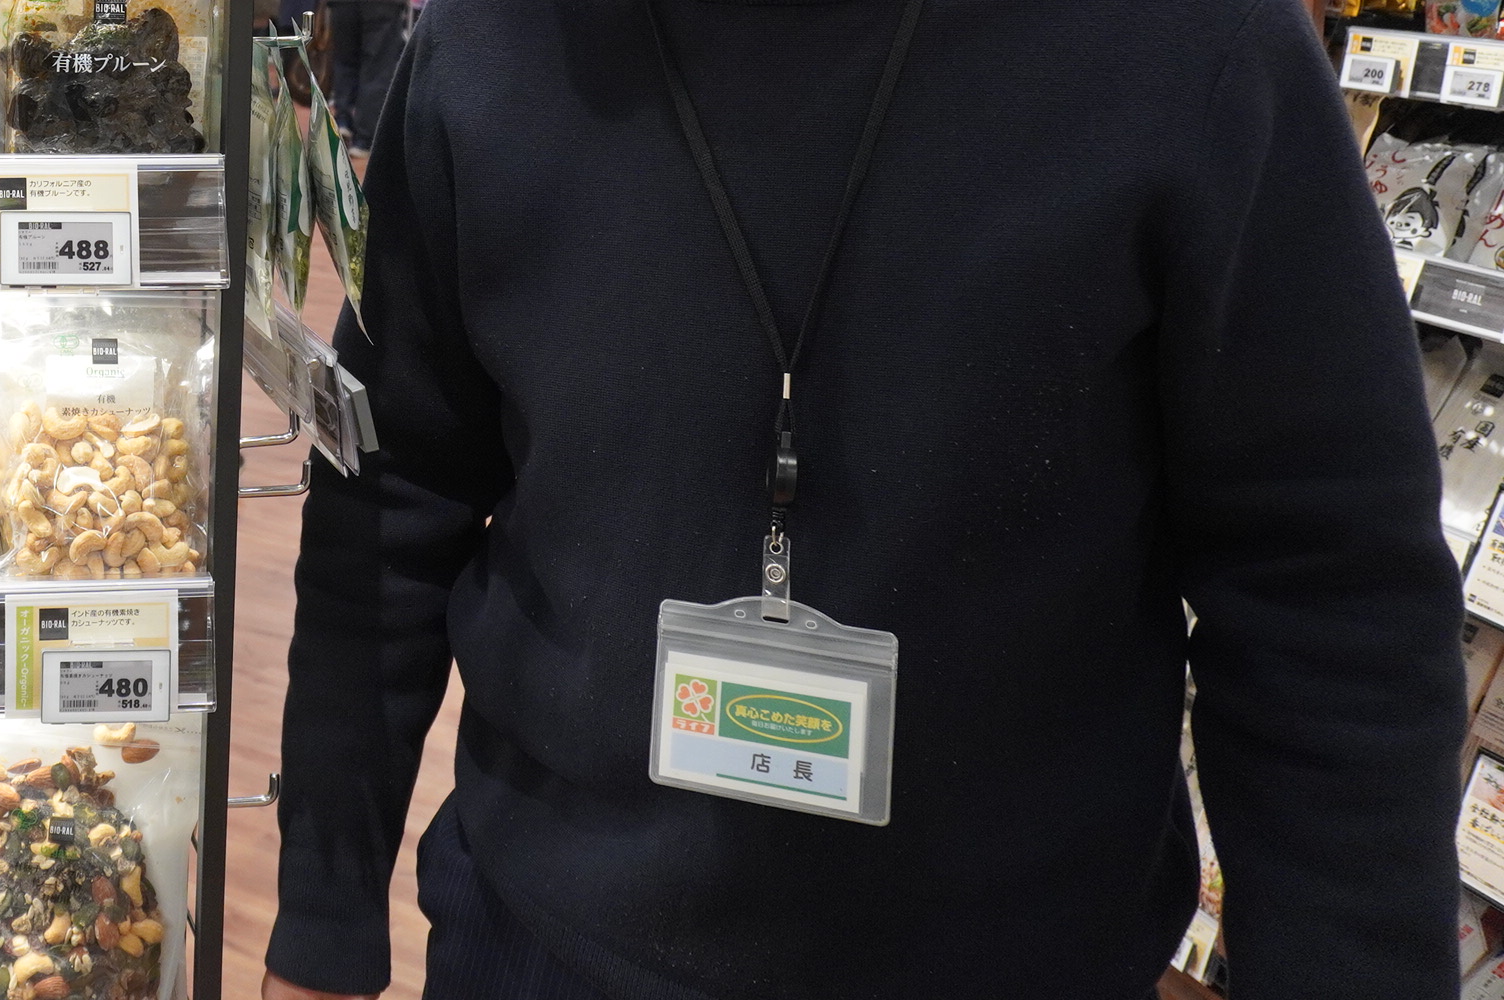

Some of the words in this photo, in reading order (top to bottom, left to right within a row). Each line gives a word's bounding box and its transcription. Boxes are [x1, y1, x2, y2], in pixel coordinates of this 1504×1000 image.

[95, 1, 126, 14] BIO-RAL
[52, 53, 167, 74] 有機プルーン
[1363, 67, 1384, 80] 200
[1467, 80, 1491, 93] 278
[28, 179, 92, 189] カリフォルニア産の
[28, 188, 92, 198] 有機プルーンです。
[58, 239, 110, 260] 488
[1452, 288, 1483, 307] BIO-RAL
[92, 347, 117, 356] BIO-RAL
[86, 367, 125, 377] Organic
[97, 394, 116, 404] 有機
[61, 407, 151, 417] 素焼きカシューナッツ
[40, 620, 66, 629] BIO-RAL
[70, 618, 136, 627] カシューナッツです。
[98, 677, 149, 698] 480
[734, 704, 833, 732] 真心こめた笑顔を
[674, 719, 714, 734] ライフ
[49, 825, 74, 836] BIO-RAL
